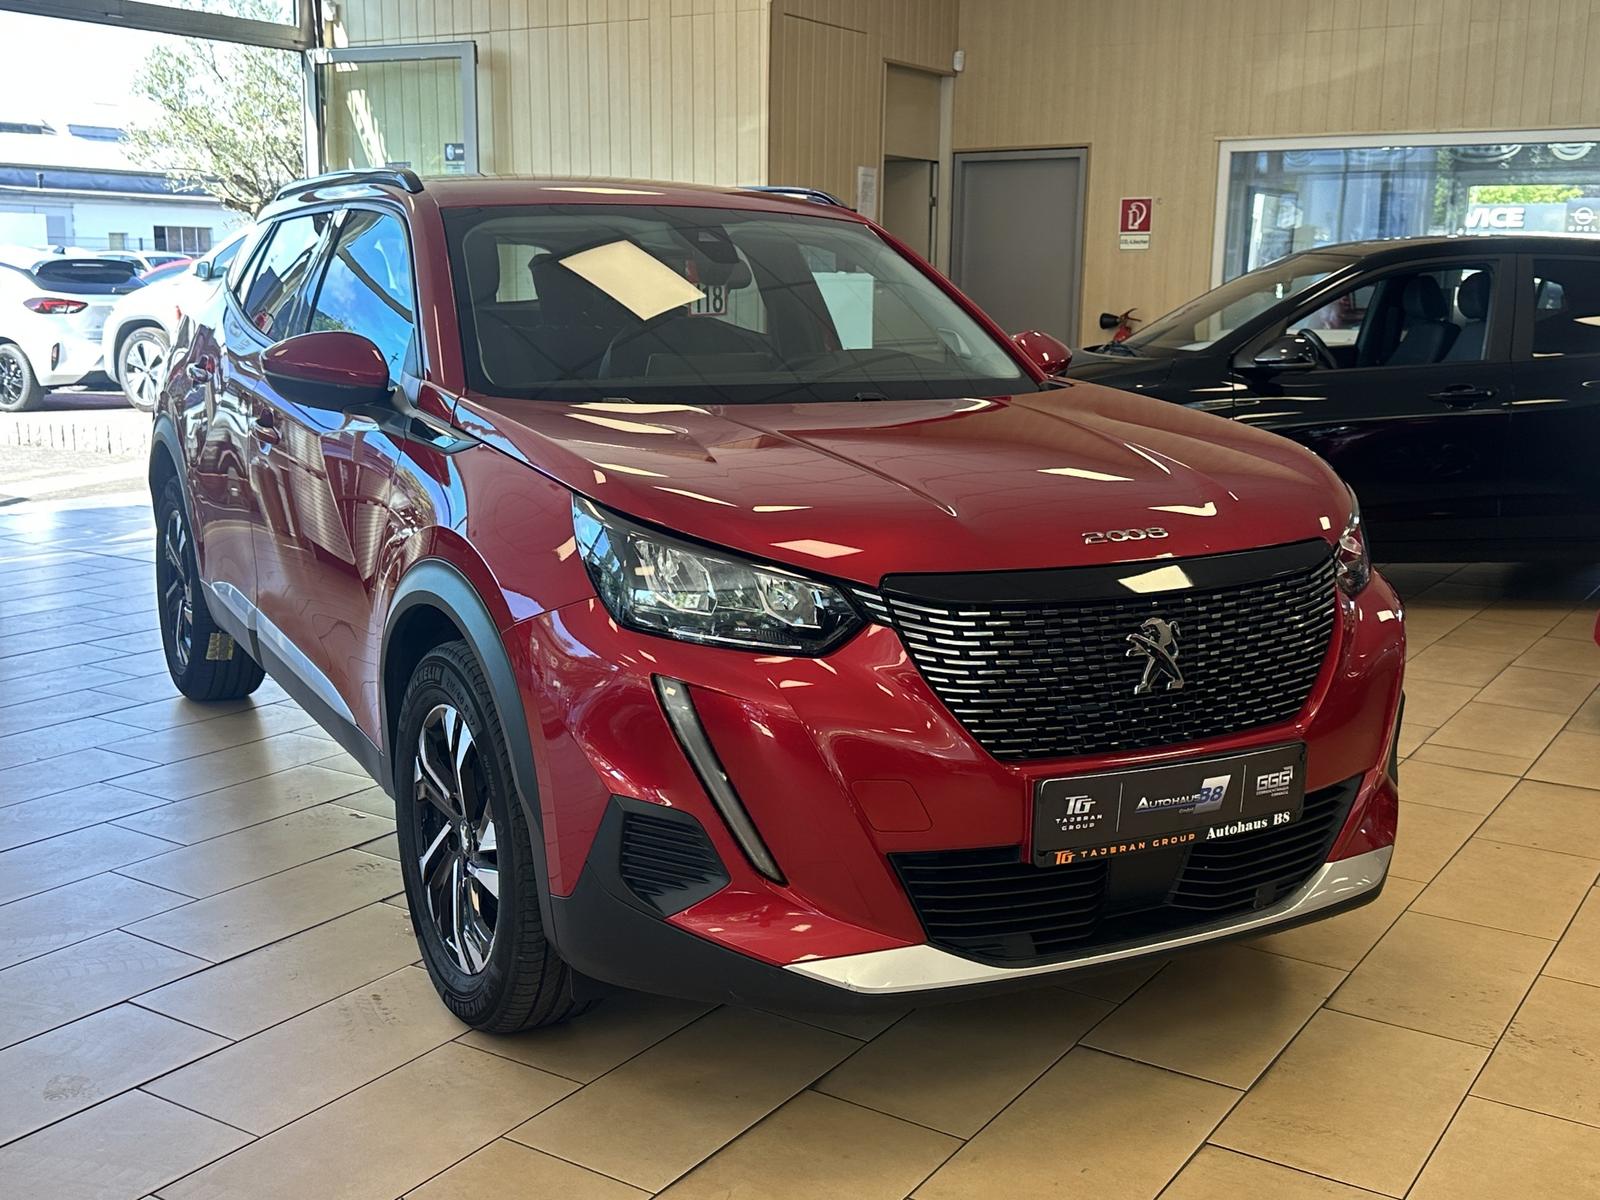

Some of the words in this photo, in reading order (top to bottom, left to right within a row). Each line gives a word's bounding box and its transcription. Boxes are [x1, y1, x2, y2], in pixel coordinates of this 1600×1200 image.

[1081, 527, 1168, 544] 2008
[1199, 785, 1224, 803] B8
[1065, 795, 1096, 815] TG
[1061, 822, 1095, 831] GROUP
[1206, 818, 1268, 840] Autohaus
[1152, 833, 1196, 847] GROUP
